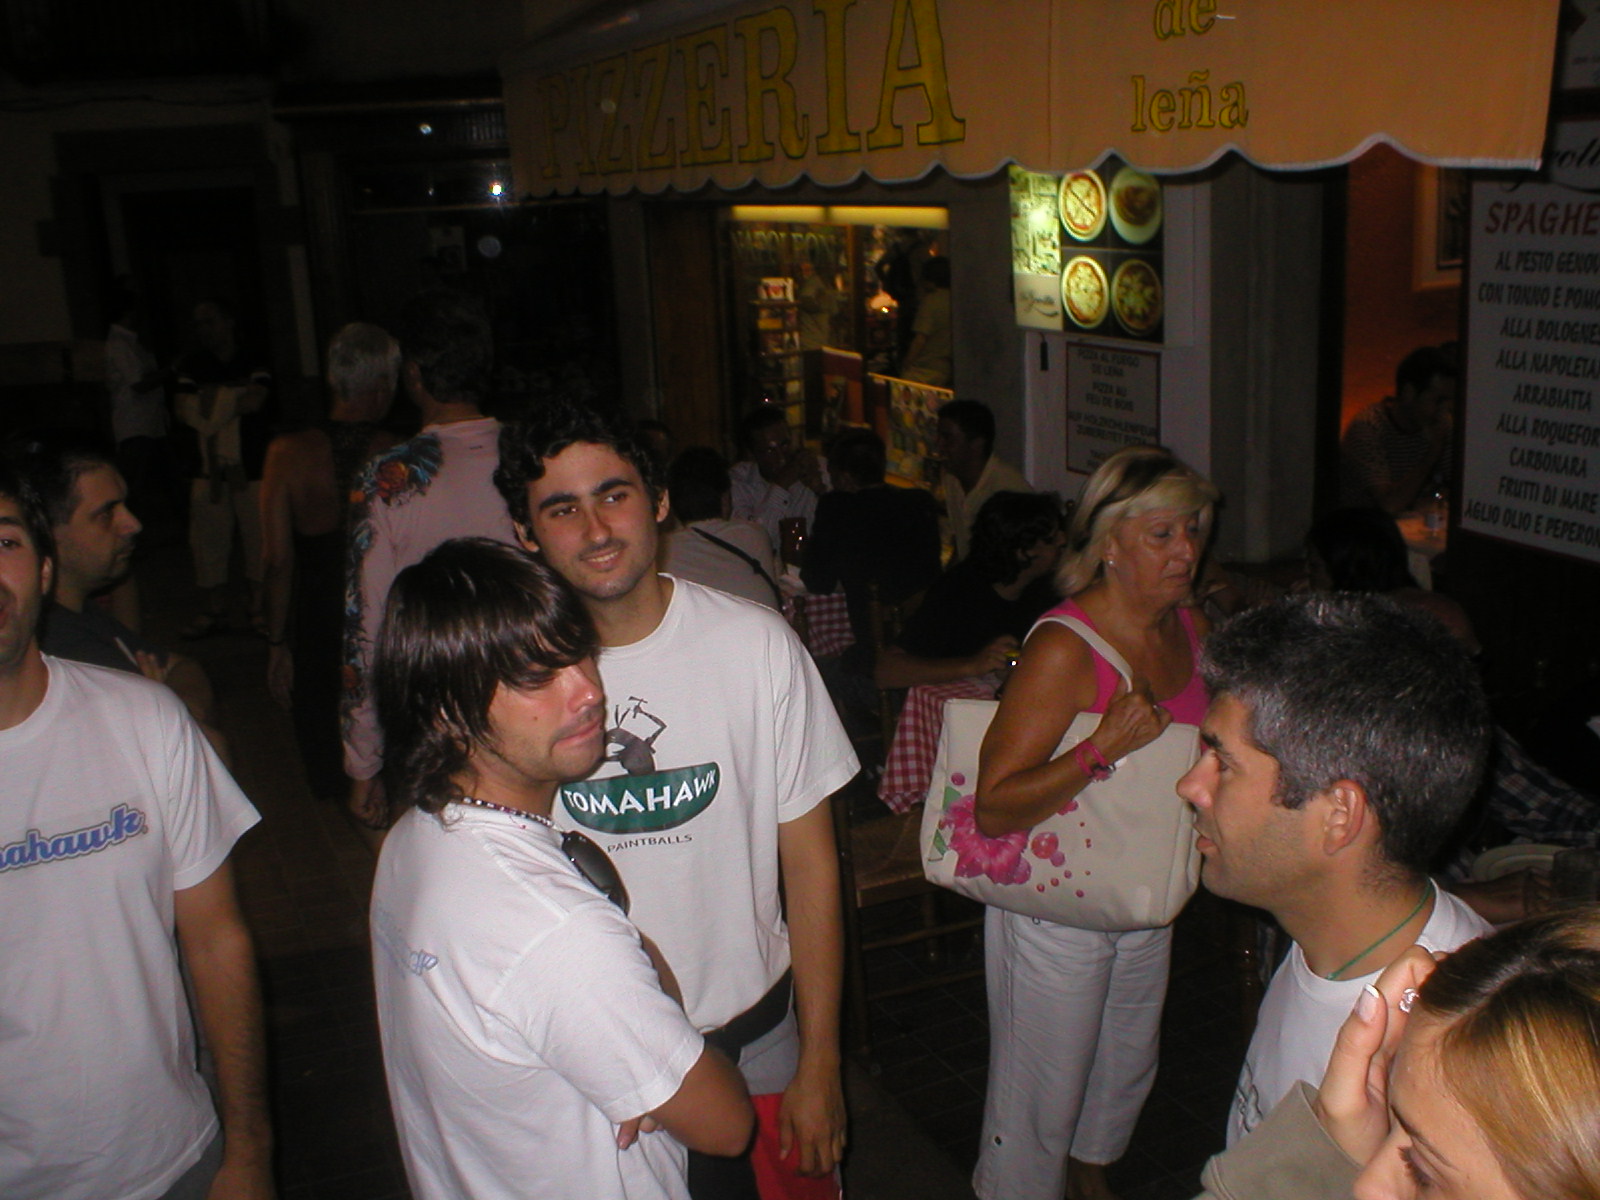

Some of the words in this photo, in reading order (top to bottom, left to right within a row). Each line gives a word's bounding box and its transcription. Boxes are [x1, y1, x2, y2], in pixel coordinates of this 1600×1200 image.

[1153, 0, 1217, 41] de
[539, 0, 966, 180] PIZZERIA
[1131, 69, 1249, 133] leña
[1485, 202, 1600, 236] SPAGHE
[1495, 251, 1511, 271] AL
[1515, 251, 1554, 273] PESTO
[1478, 282, 1504, 303] CON
[1507, 284, 1550, 307] TONNO
[1553, 286, 1562, 308] E
[1500, 317, 1532, 339] ALLA
[1496, 350, 1527, 371] ALLA
[1513, 384, 1592, 412] ARRABIATTA
[1496, 413, 1527, 435] ALLA
[1509, 447, 1587, 479] CARBONARA
[1498, 476, 1540, 502] FRUTTI
[1542, 485, 1557, 505] DI
[1559, 489, 1599, 515] MARE
[1464, 499, 1500, 525] AGLIO
[1502, 507, 1532, 531] OLIO
[1535, 514, 1544, 534] E
[563, 769, 717, 816] TOMAHAWK
[607, 834, 693, 853] PAINTBALLS
